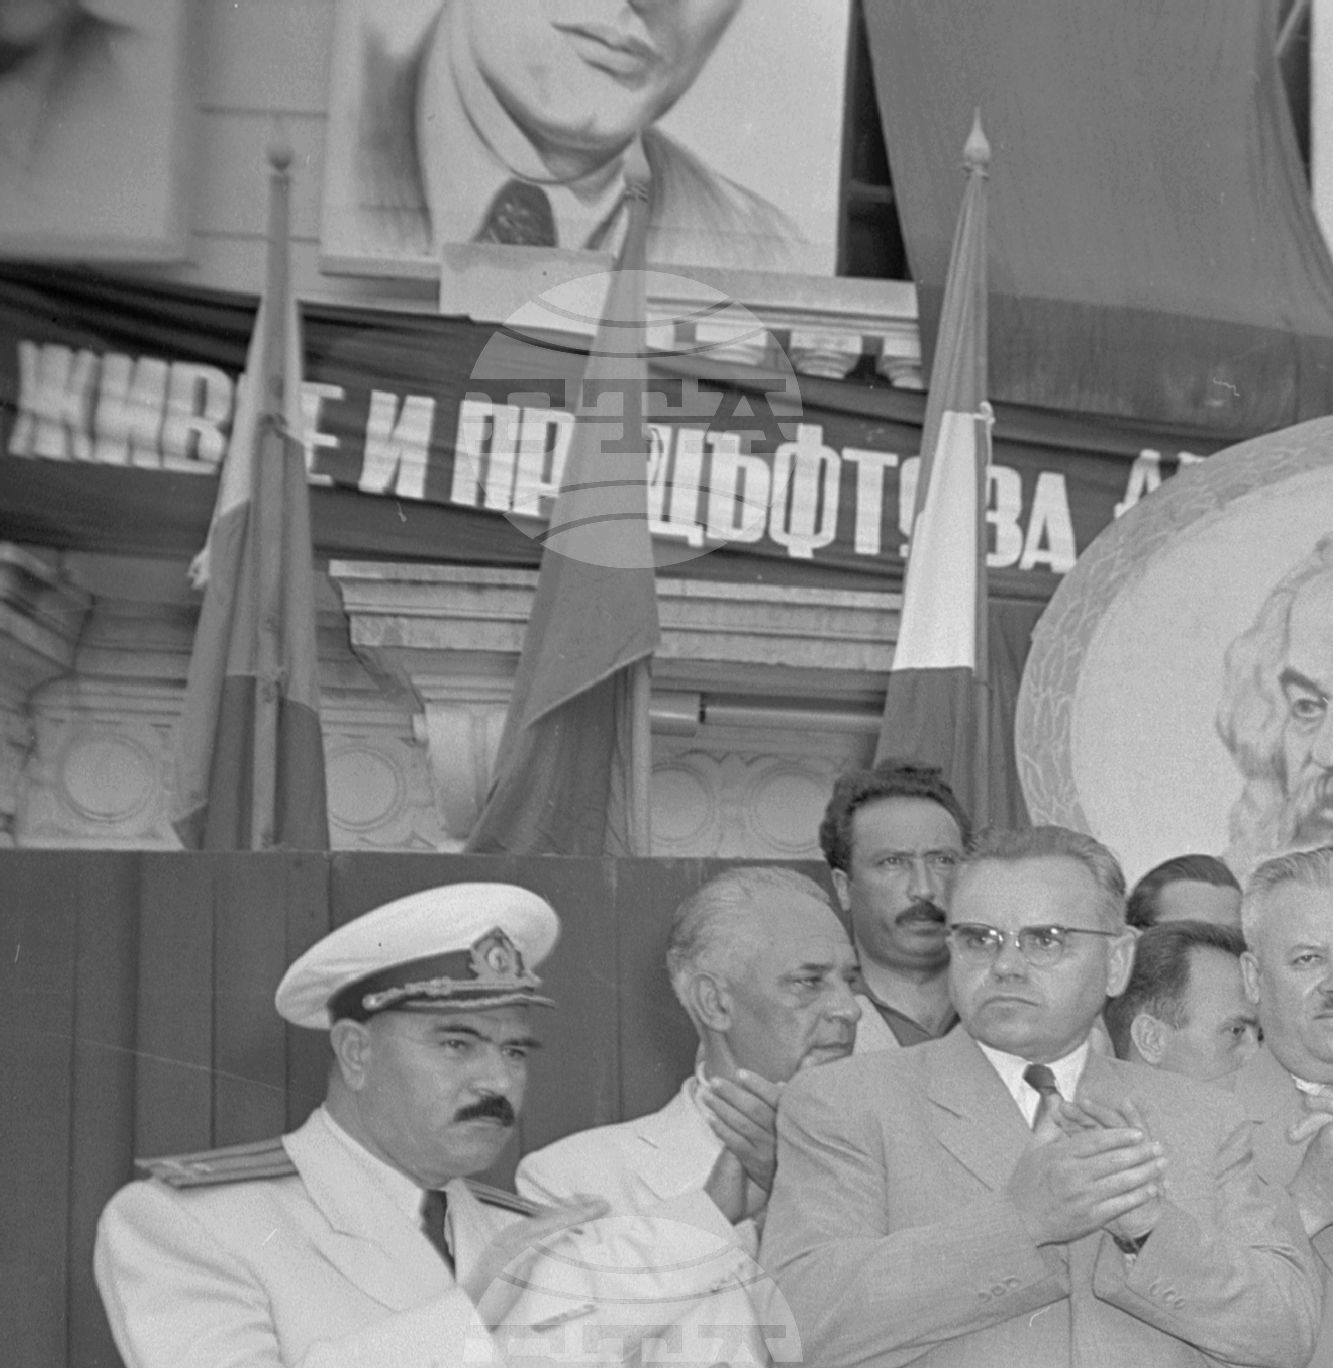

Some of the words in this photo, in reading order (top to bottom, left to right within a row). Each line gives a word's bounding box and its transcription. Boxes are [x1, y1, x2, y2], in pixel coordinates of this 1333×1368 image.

[8, 339, 345, 486] ЖИВЕ
[358, 389, 436, 499] И
[450, 398, 1077, 573] ПРЦЪФТВА
